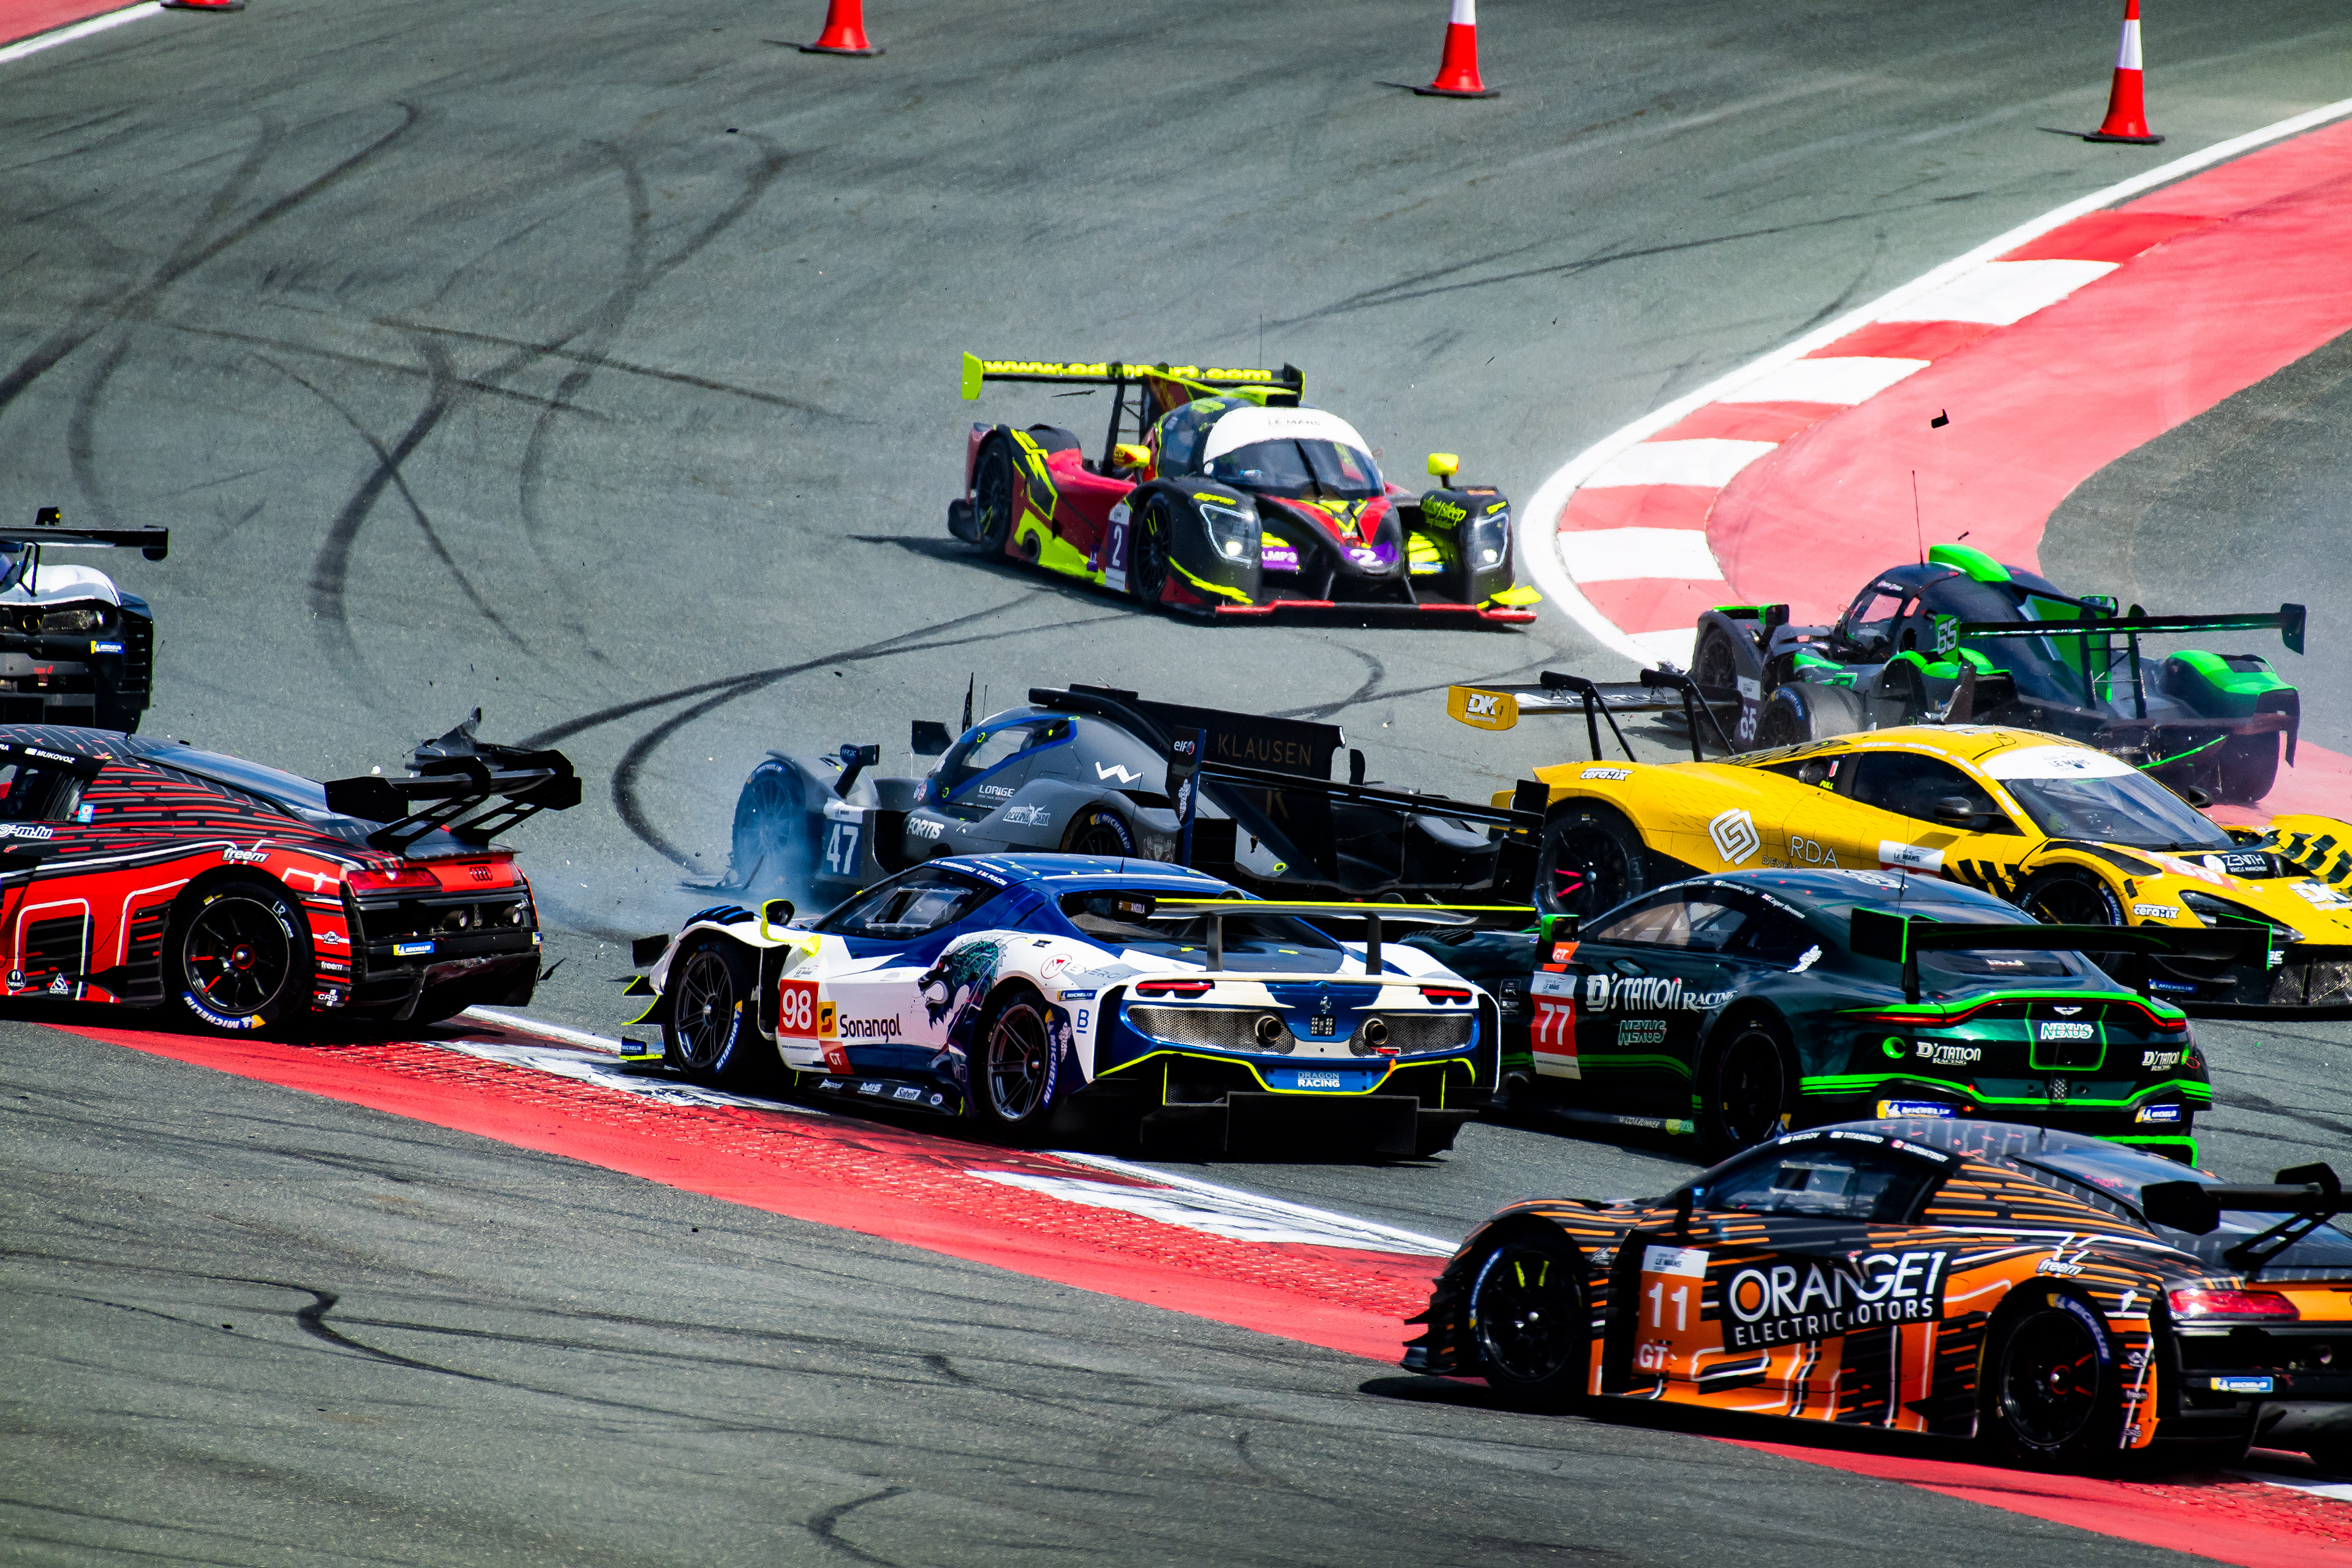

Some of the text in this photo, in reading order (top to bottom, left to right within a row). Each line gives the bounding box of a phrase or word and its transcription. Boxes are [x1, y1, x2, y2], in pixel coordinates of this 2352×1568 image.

[1112, 525, 1122, 566] 2
[1262, 551, 1297, 564] LMP3
[1350, 549, 1383, 567] 2
[1937, 617, 1957, 655] 65
[1467, 693, 1500, 715] DK
[36, 750, 75, 764] MUKOVOZ
[1174, 741, 1188, 752] elf
[1218, 733, 1311, 766] KLAUSEN
[1820, 780, 1833, 790] PULL
[907, 818, 944, 839] FORTIS
[1102, 815, 1130, 849] MICHELIN
[224, 847, 269, 863] freem
[827, 824, 858, 875] 47
[1790, 835, 1840, 869] RDA
[321, 961, 343, 970] freem
[184, 996, 239, 1029] MICHELIN
[782, 988, 812, 1030] 98
[839, 1014, 902, 1043] Sonangol
[1539, 1002, 1570, 1046] 77
[1617, 1020, 1667, 1046] NEXUS
[2041, 1022, 2094, 1040] NEXUS
[716, 1022, 738, 1070] MICHELIN
[829, 1052, 842, 1066] GT
[1043, 1034, 1057, 1104] MICHELIN
[859, 1082, 883, 1092] MIS
[897, 1088, 918, 1100] Sabelt
[2038, 1259, 2082, 1276] freem
[1728, 1251, 1947, 1322] ORANGE1
[1648, 1282, 1688, 1332] 11
[1734, 1310, 1844, 1346] ELECTRIC
[1639, 1344, 1668, 1370] GT
